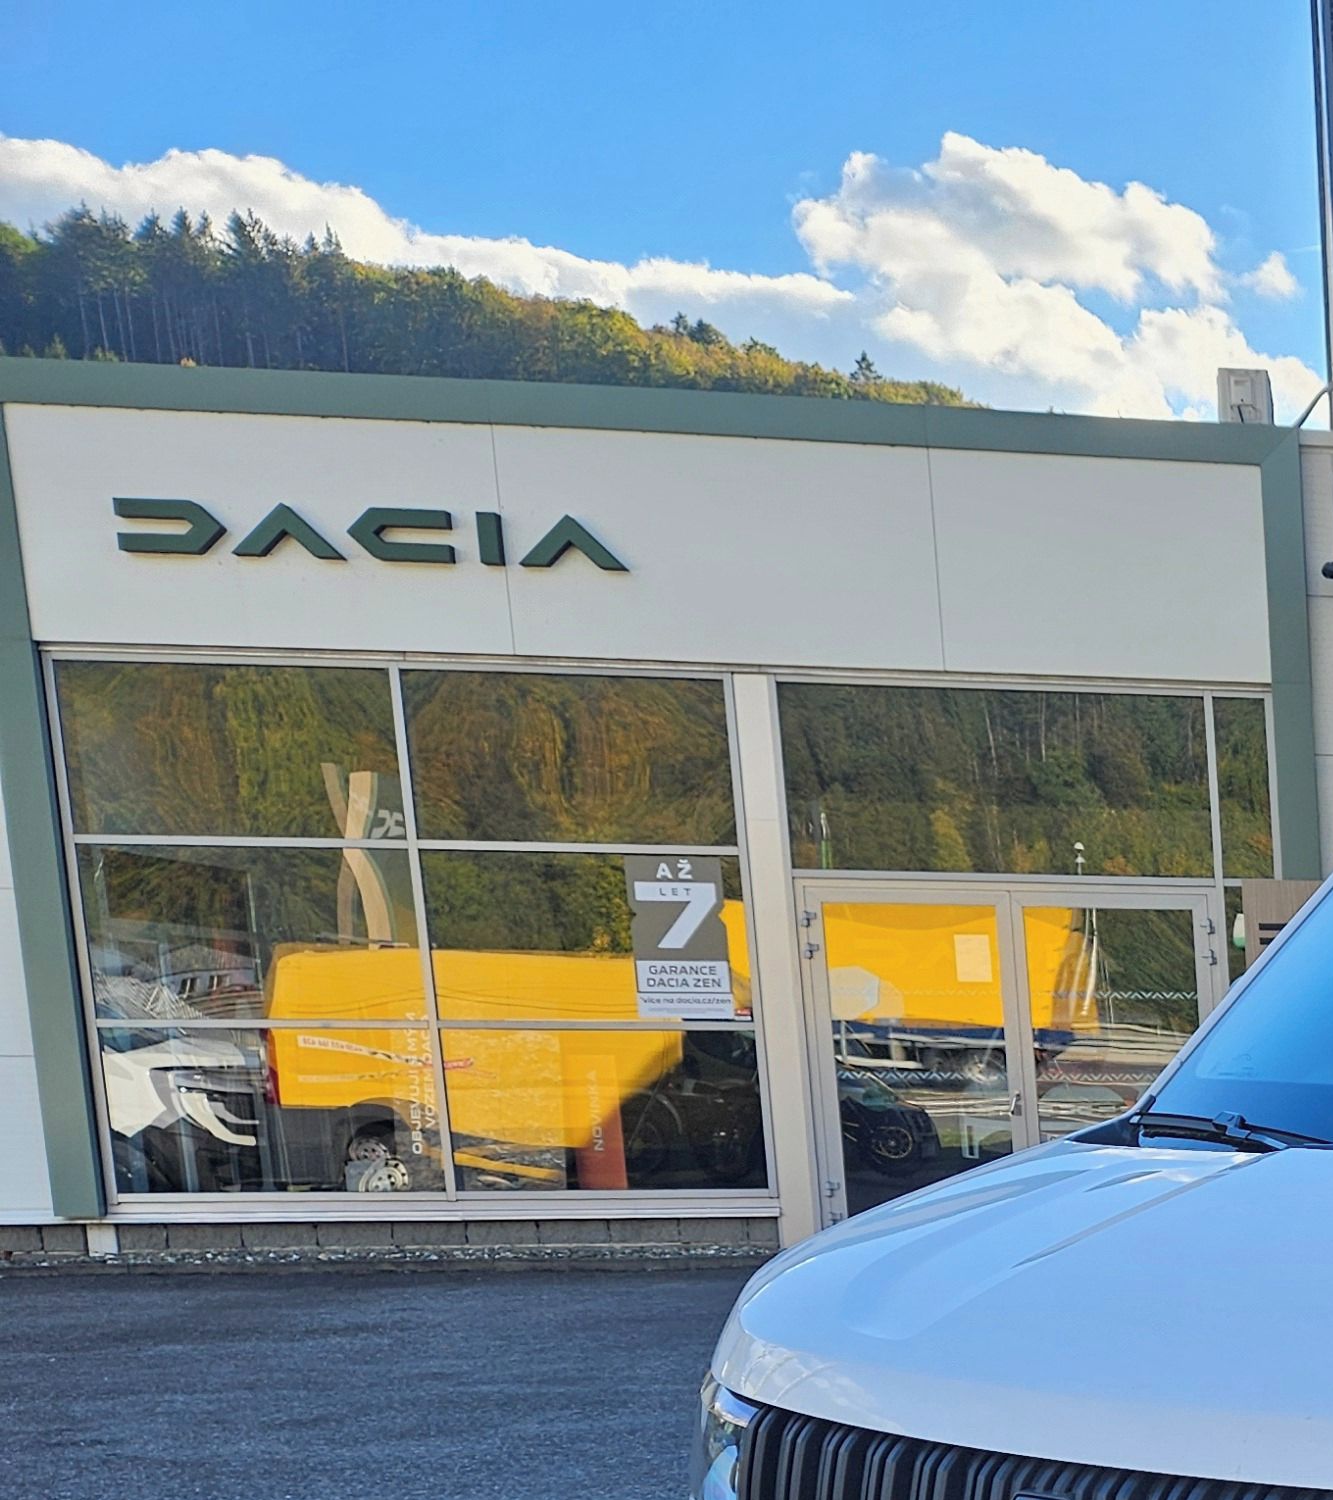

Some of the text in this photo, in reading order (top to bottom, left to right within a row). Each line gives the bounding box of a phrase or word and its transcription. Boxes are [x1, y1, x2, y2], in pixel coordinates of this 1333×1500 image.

[112, 497, 631, 572] DACIA
[656, 859, 693, 880] AŽ
[659, 887, 692, 897] LET
[634, 881, 717, 949] 7
[648, 964, 718, 976] GARANCE
[646, 977, 722, 988] DACIA ZEN
[586, 1070, 605, 1152] NOVINKA
